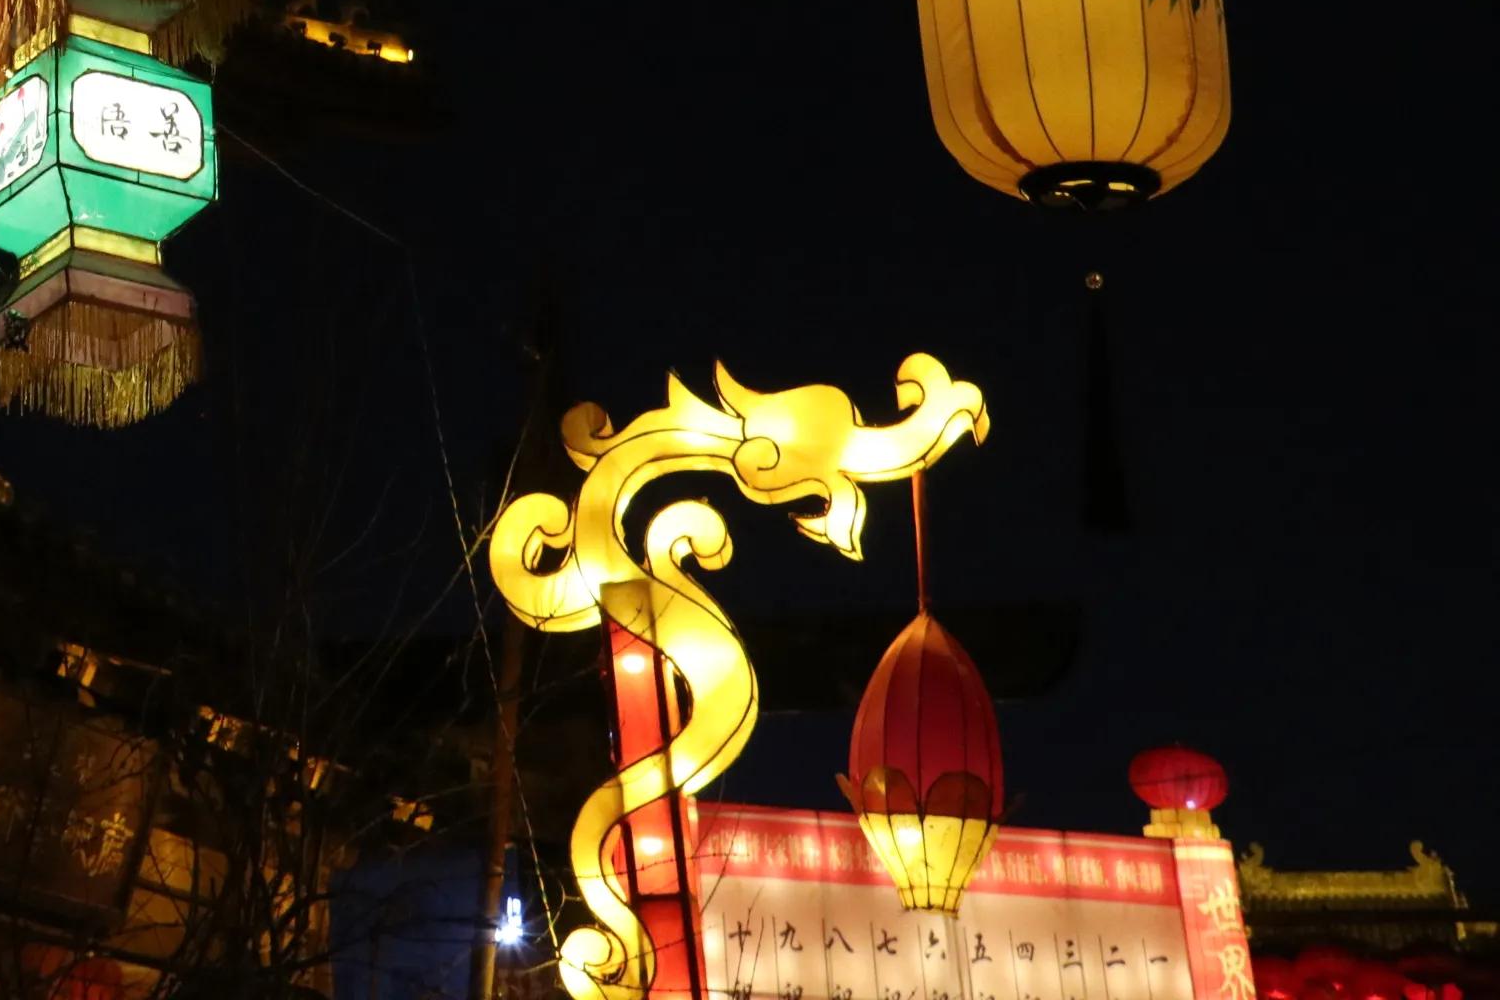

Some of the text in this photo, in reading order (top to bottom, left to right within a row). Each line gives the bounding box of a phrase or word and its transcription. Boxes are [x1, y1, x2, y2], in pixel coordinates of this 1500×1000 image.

[729, 921, 752, 951] 十
[779, 921, 803, 951] 九
[825, 927, 854, 953] 八
[877, 929, 898, 954] 七
[924, 930, 947, 960] 六
[971, 932, 993, 963] 五
[1016, 941, 1035, 962] 四
[1063, 939, 1083, 968] 三
[1106, 945, 1127, 967] 二
